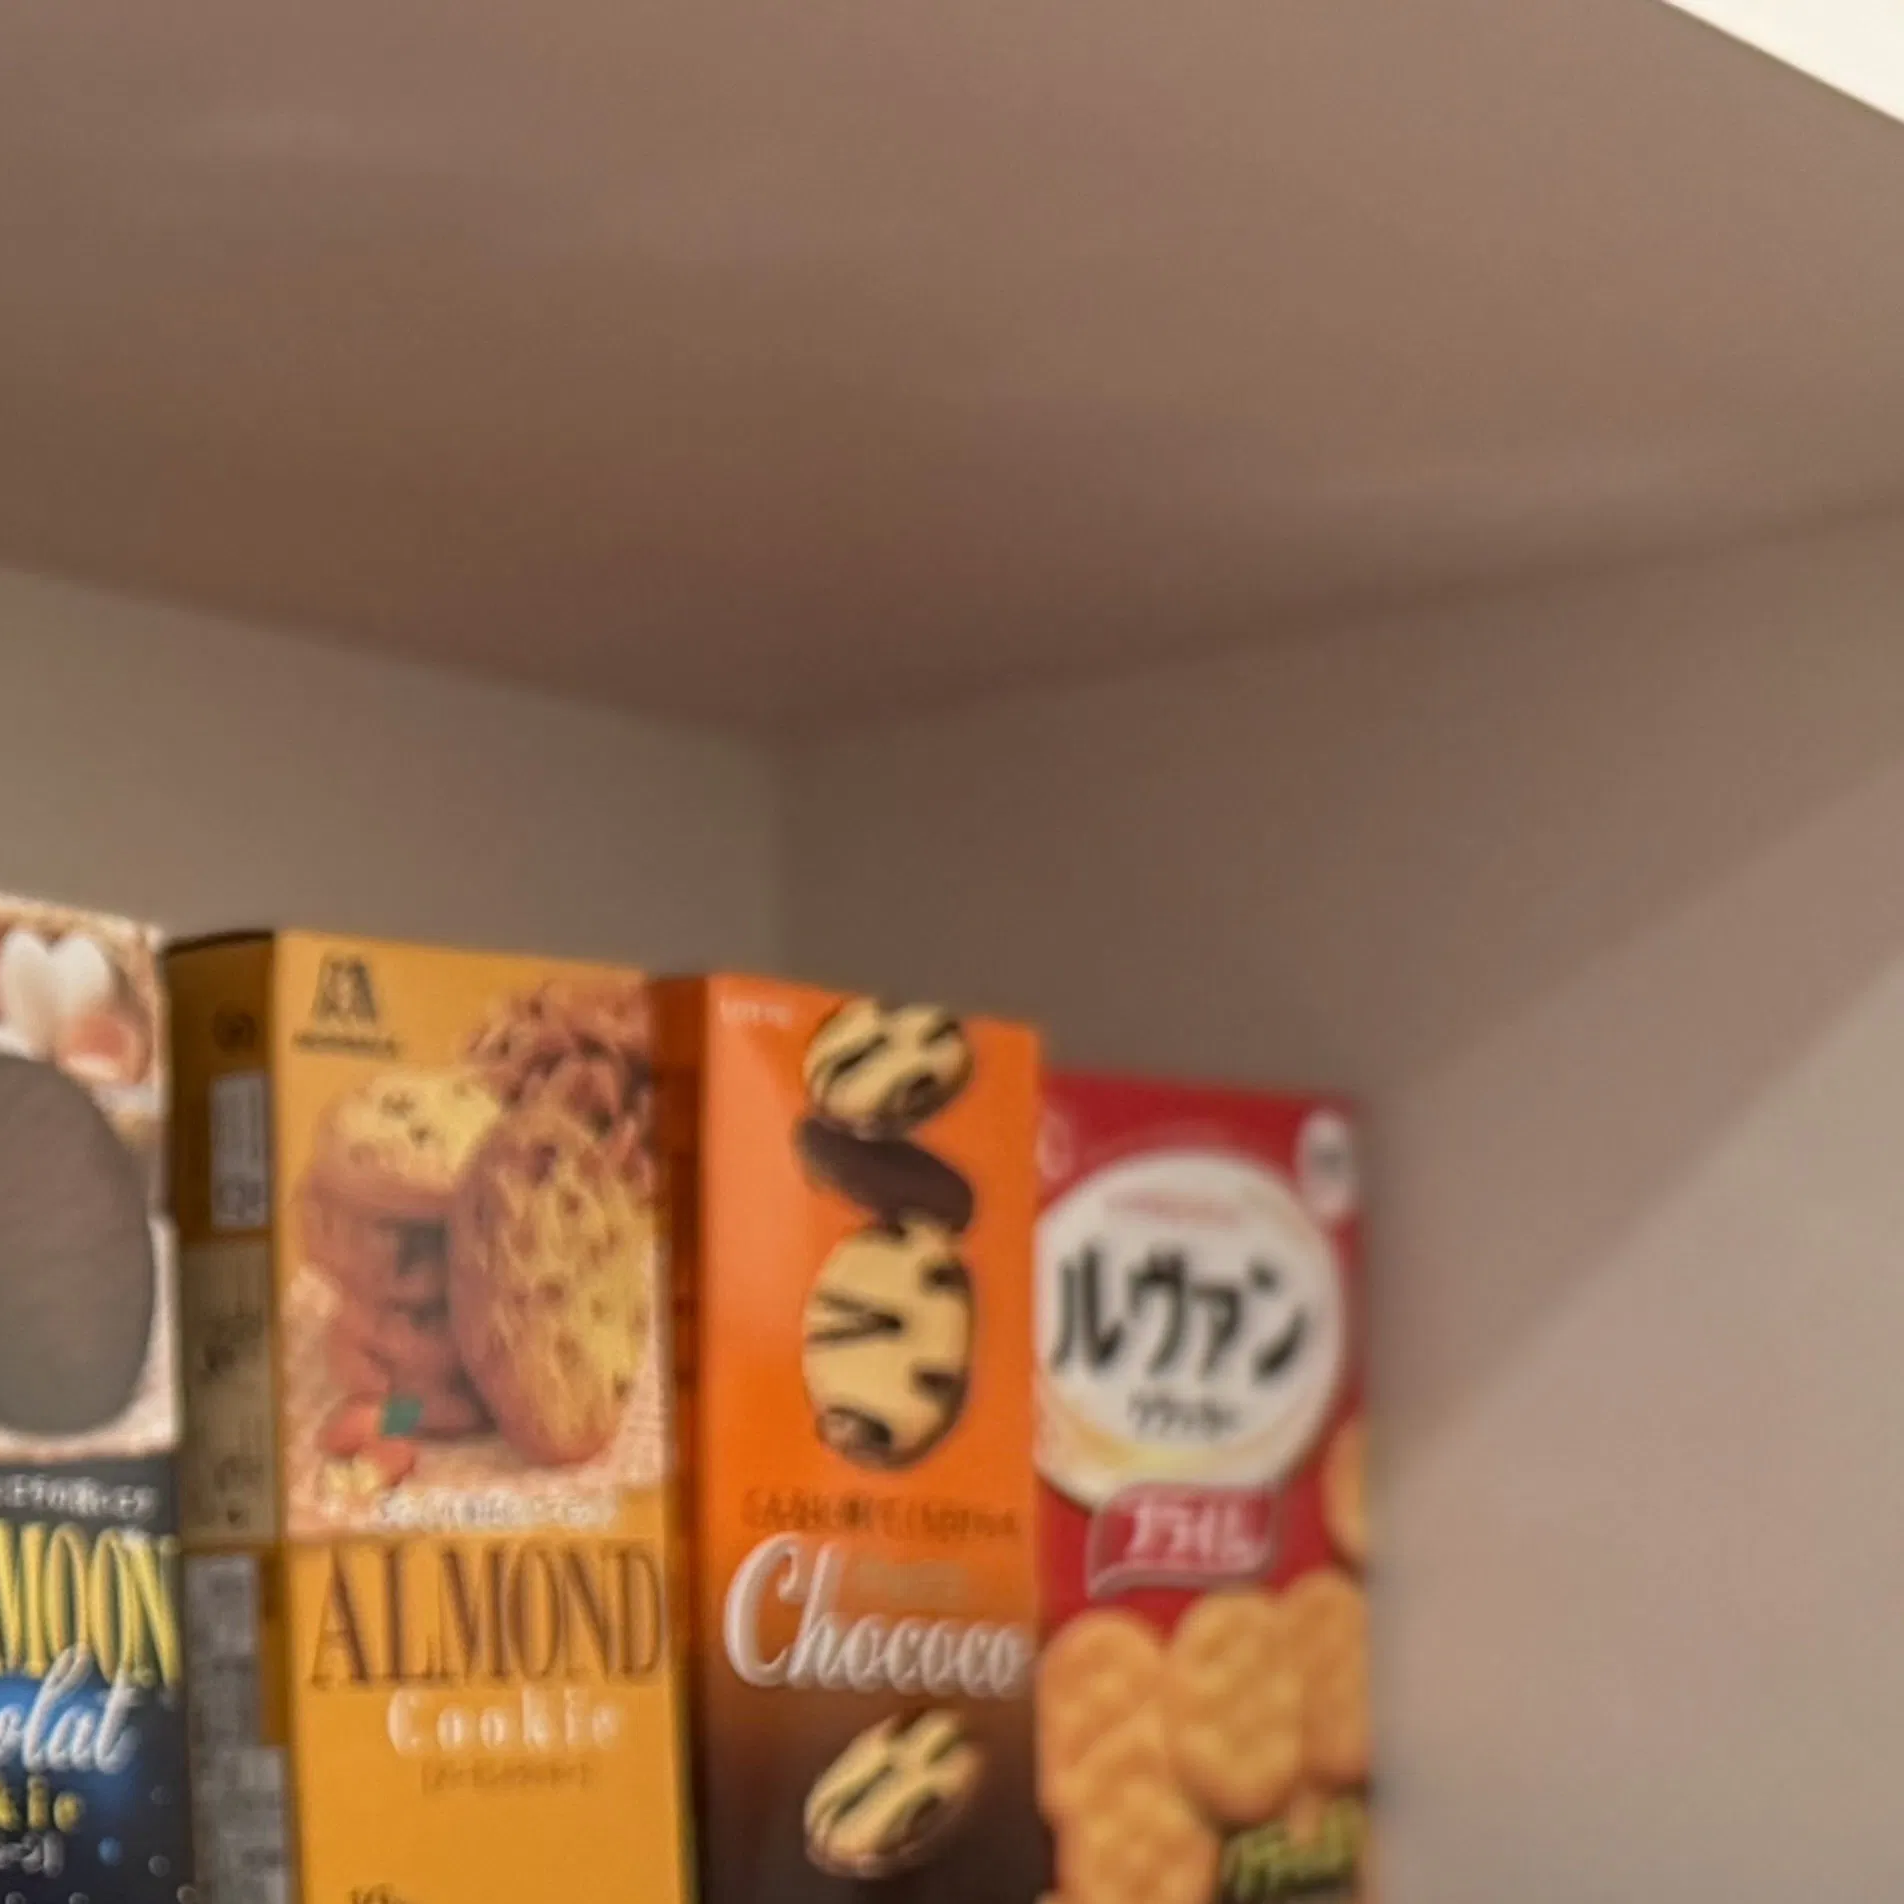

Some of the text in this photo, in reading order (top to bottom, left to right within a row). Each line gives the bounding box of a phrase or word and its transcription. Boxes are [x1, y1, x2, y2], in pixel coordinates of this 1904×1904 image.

[1050, 1242, 1312, 1386] ルヴァン
[311, 1539, 664, 1690] ALMOND
[724, 1530, 1031, 1698] Chococo
[387, 1687, 621, 1756] Cookie
